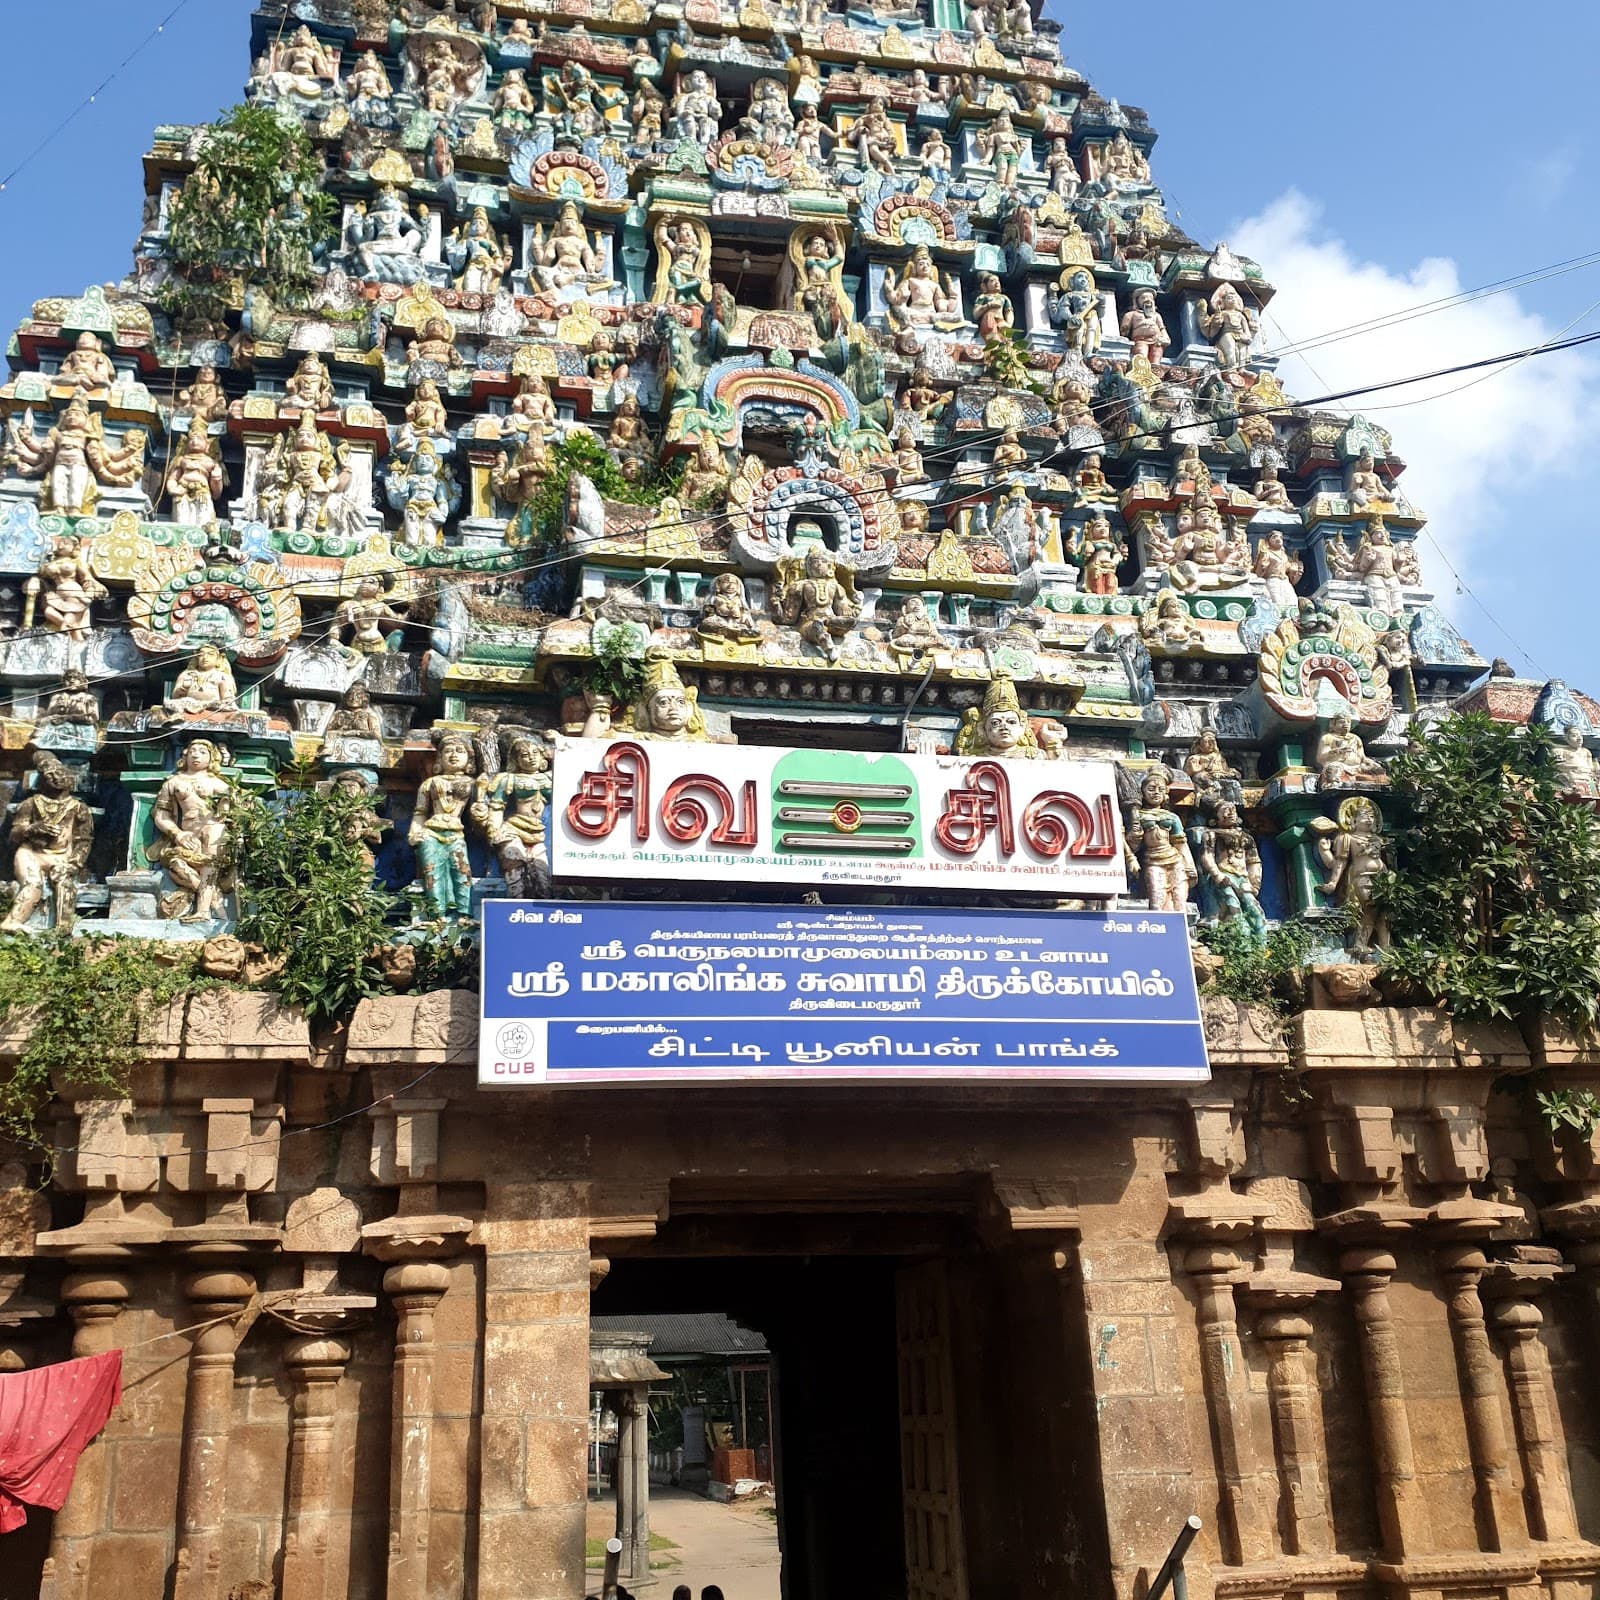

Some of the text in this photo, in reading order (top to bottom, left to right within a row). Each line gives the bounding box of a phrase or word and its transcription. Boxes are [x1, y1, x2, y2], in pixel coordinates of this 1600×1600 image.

[567, 741, 758, 845] சிவ
[936, 760, 1117, 856] சிவ
[632, 851, 826, 867] பெருநலமாமுலையம்மை
[929, 860, 1006, 873] மகாலிங்க
[1010, 864, 1060, 875] சுவாமி
[822, 872, 902, 883] திருவிடைமருதூர்
[509, 909, 583, 924] சிவ சிவ
[1103, 919, 1167, 934] சிவ சிவ
[580, 939, 1109, 963] ஸ்ரீ பெருநலமாமுலையம்மை உடனாய
[507, 961, 1175, 1000] ஸ்ரீ மகாலிங்க சுவாமி திருக்கோயில்
[789, 998, 921, 1011] திருவிடைமருதூர்
[576, 1024, 677, 1035] இறைபணியில்...
[648, 1035, 1119, 1063] சிட்டி யூனியன் பாங்க்
[495, 1062, 535, 1074] CUB
